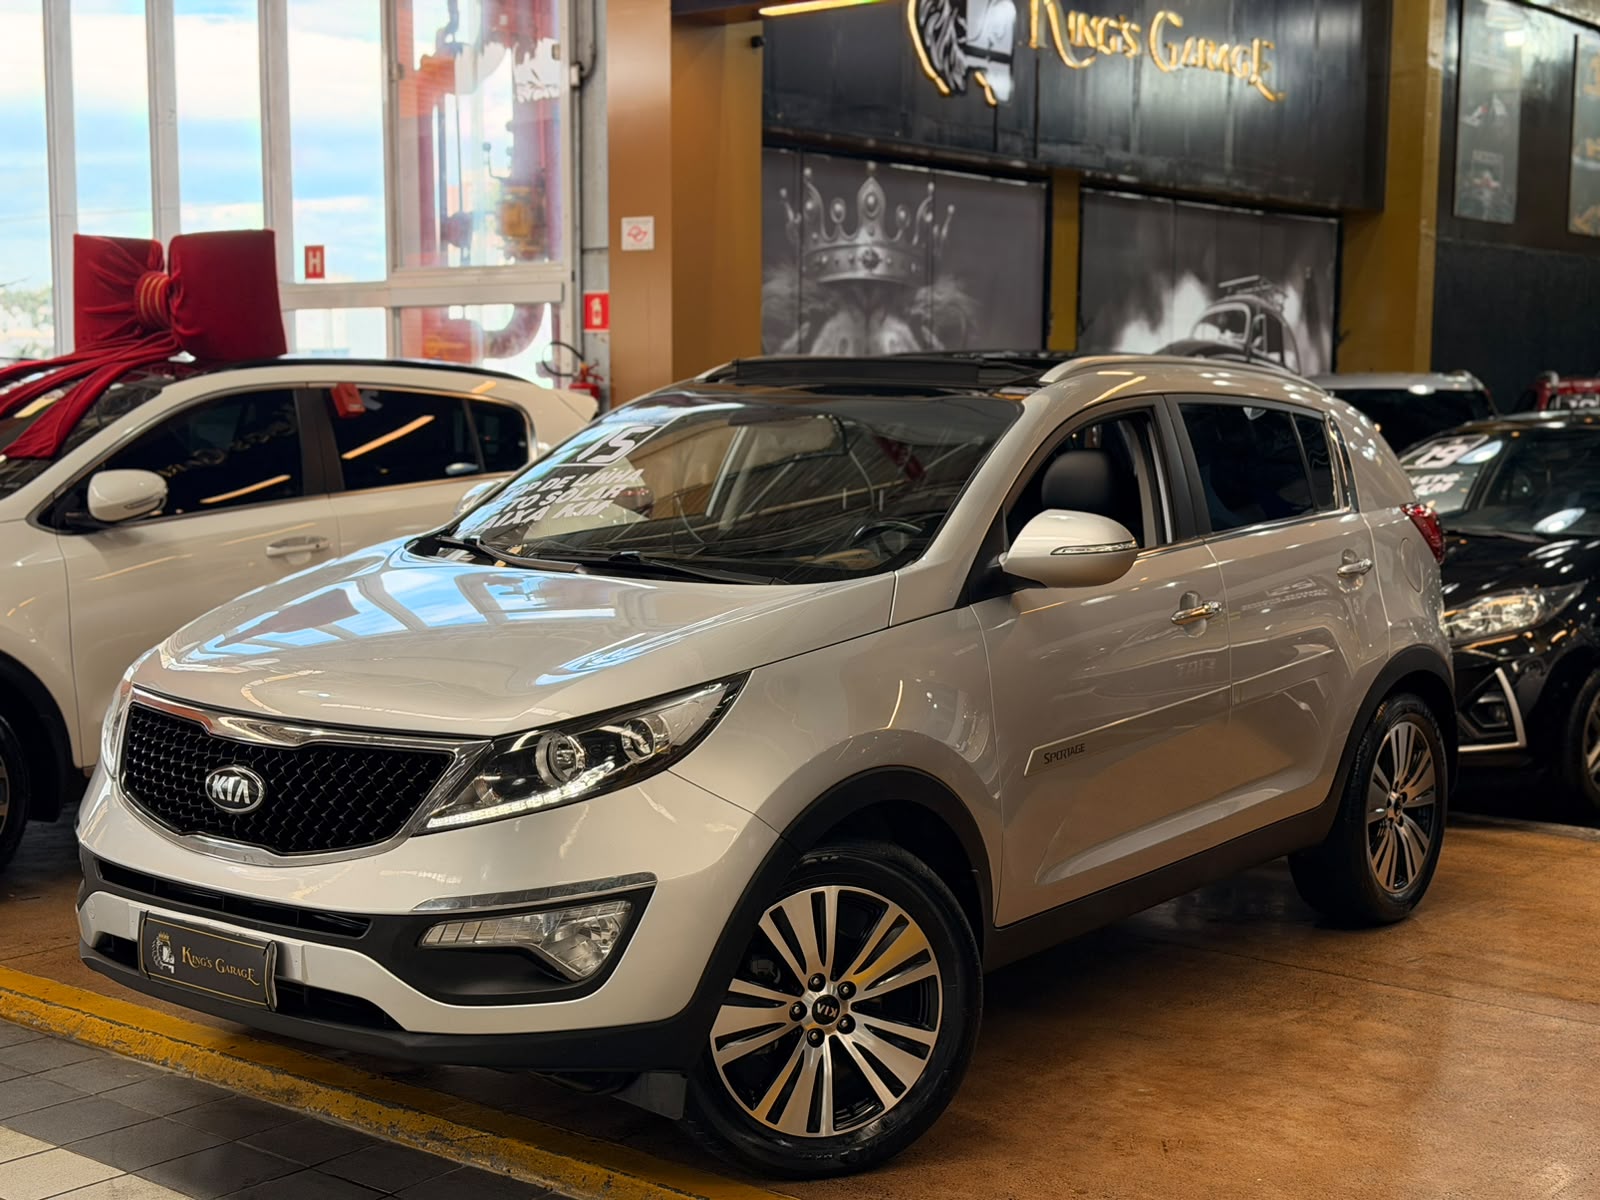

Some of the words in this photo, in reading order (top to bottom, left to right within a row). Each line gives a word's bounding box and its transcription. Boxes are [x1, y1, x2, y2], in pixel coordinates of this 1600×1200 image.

[1148, 10, 1287, 102] GARAGE
[308, 250, 321, 274] H
[542, 475, 577, 492] DE
[572, 468, 645, 488] LINHA
[543, 484, 627, 508] SOLAR
[466, 505, 551, 534] AIXA
[552, 498, 614, 520] KM
[1043, 743, 1086, 765] SPORTAGE
[211, 774, 251, 805] KIA
[215, 957, 261, 986] GARAGE
[816, 1002, 838, 1018] KIA
